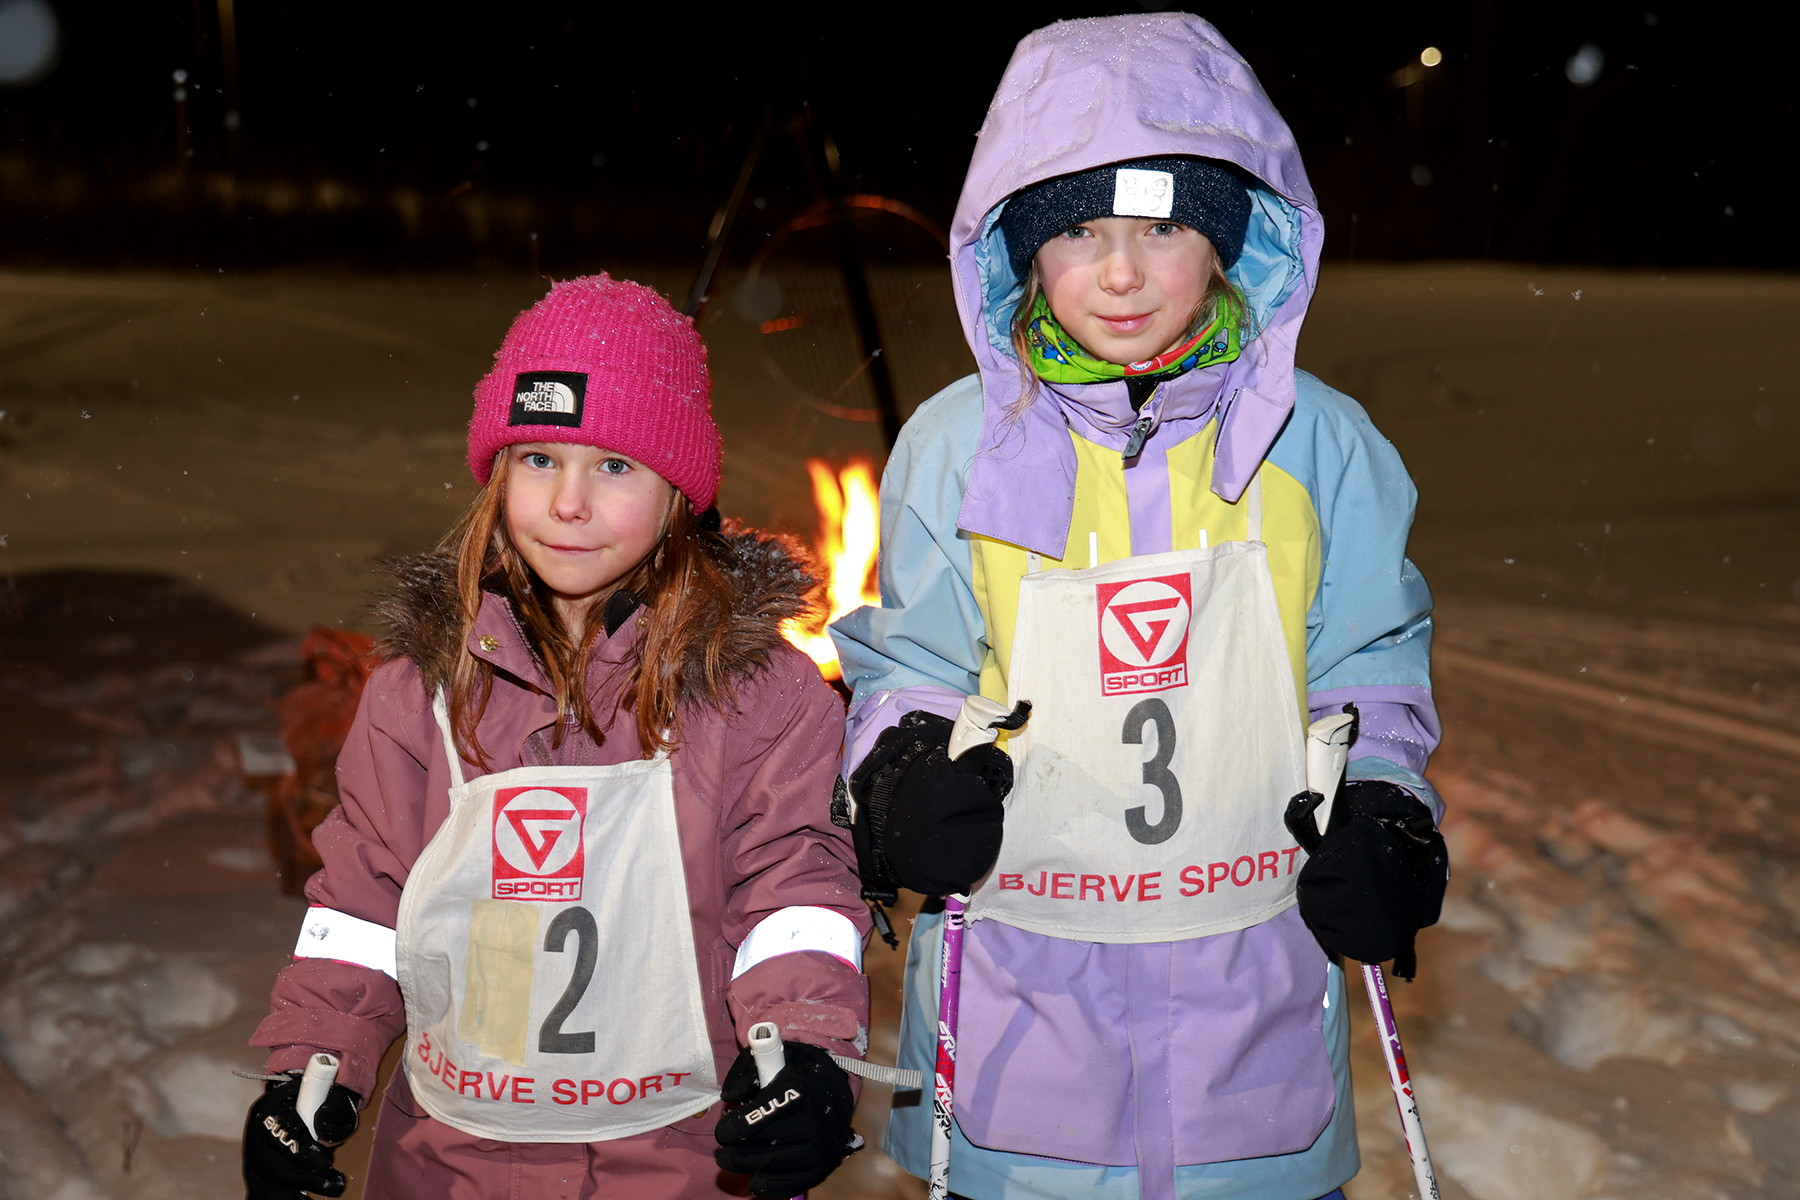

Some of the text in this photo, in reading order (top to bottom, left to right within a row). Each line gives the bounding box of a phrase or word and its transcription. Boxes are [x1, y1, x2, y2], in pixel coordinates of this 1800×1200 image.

[516, 391, 552, 403] NORTH
[533, 382, 555, 392] THE
[524, 401, 552, 412] FACE
[1106, 667, 1183, 690] SPORT
[1121, 697, 1184, 846] 3
[497, 881, 579, 895] SPORT
[999, 845, 1301, 902] BJERVE SPORT
[538, 905, 598, 1054] 2
[418, 1032, 692, 1106] BJERVE SPORT
[744, 1088, 801, 1126] BULA
[262, 1115, 299, 1154] BULA
